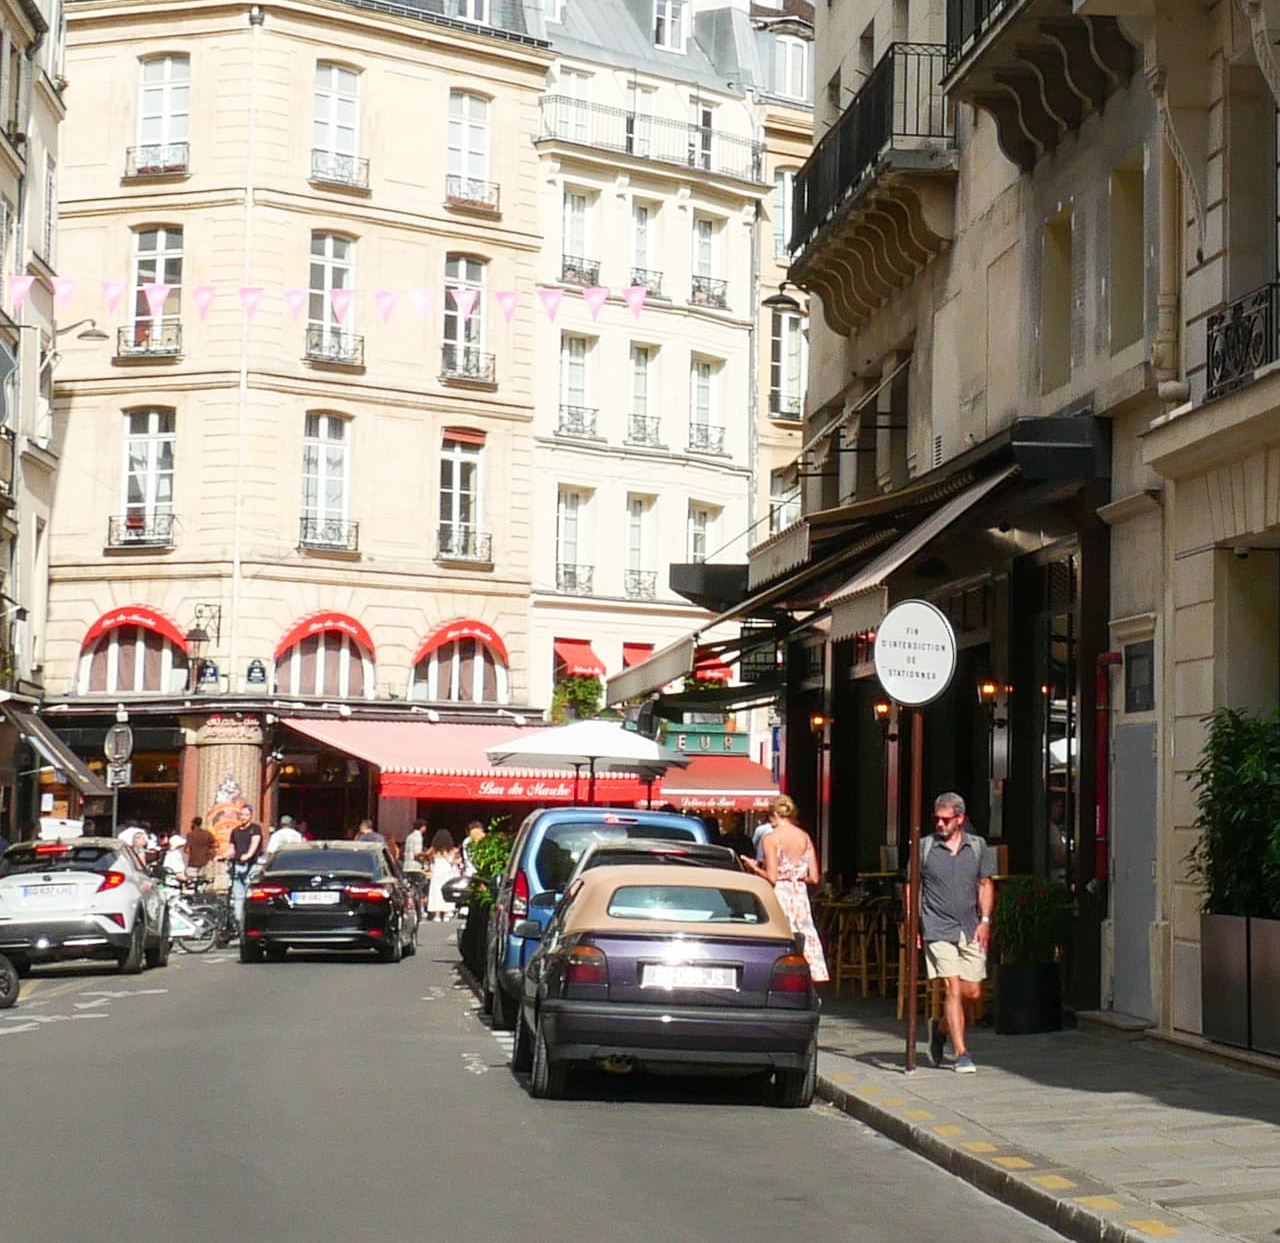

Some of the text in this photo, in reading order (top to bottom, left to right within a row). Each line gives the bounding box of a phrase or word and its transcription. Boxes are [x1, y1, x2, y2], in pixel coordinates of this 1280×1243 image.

[906, 627, 919, 635] FIN
[881, 640, 946, 651] D'INTERDICTION
[906, 655, 917, 664] DE
[888, 669, 936, 679] STATIONNER
[478, 781, 504, 795] Bar
[507, 781, 524, 795] du
